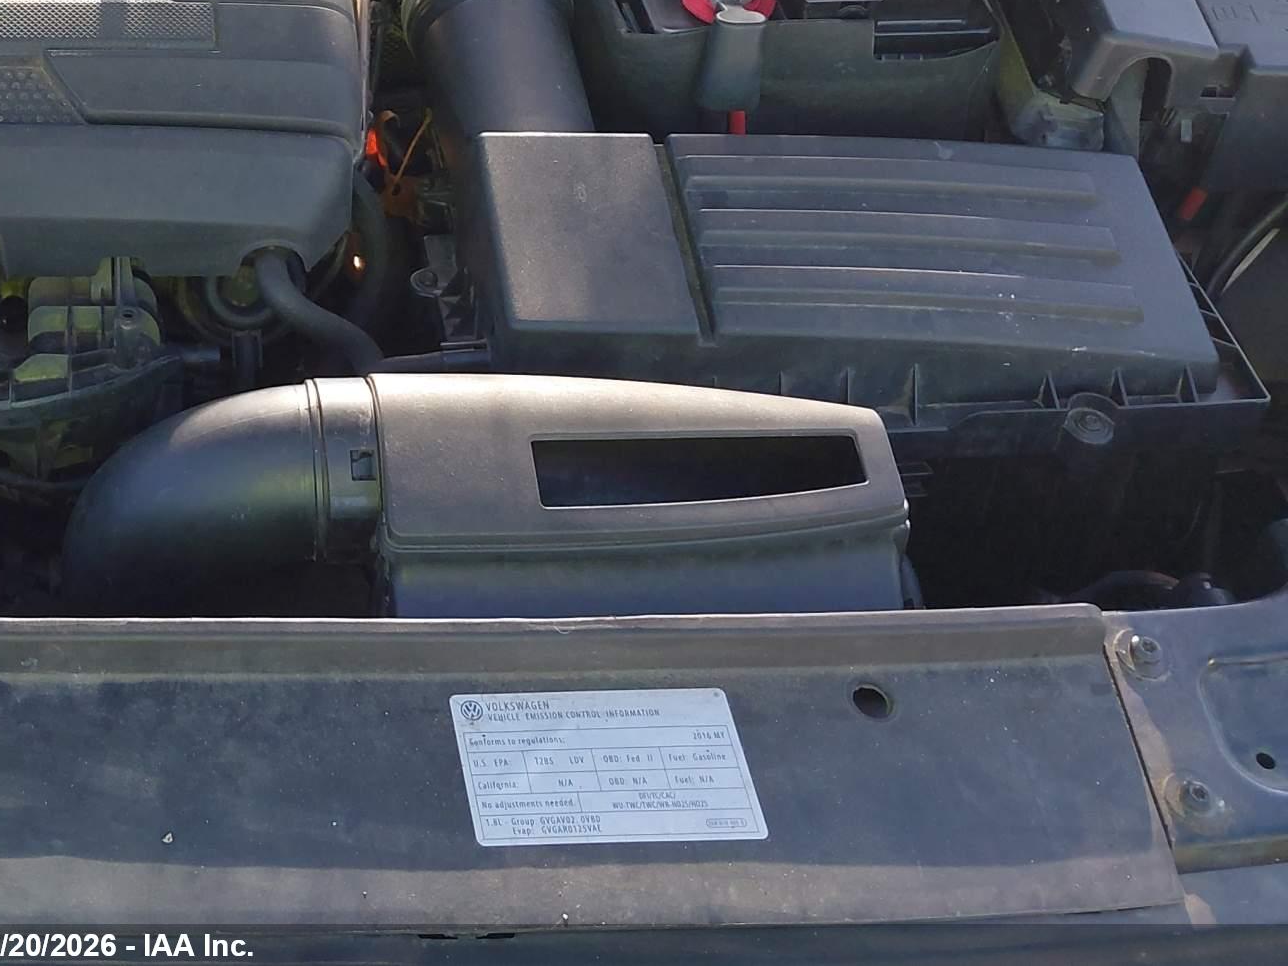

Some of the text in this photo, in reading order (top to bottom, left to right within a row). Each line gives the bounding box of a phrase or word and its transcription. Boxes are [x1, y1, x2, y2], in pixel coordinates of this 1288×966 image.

[485, 701, 550, 711] VOLKSWAGEN
[487, 707, 660, 722] VEHICLE EMISSION CONTROL INFORMATION
[569, 755, 585, 764] LDV
[626, 753, 641, 762] Fed
[692, 752, 726, 762] Gasoline
[558, 779, 574, 787] N/A
[632, 776, 648, 785] N/A
[699, 775, 714, 784] N/A
[482, 801, 493, 809] No
[495, 800, 543, 811] adjustments
